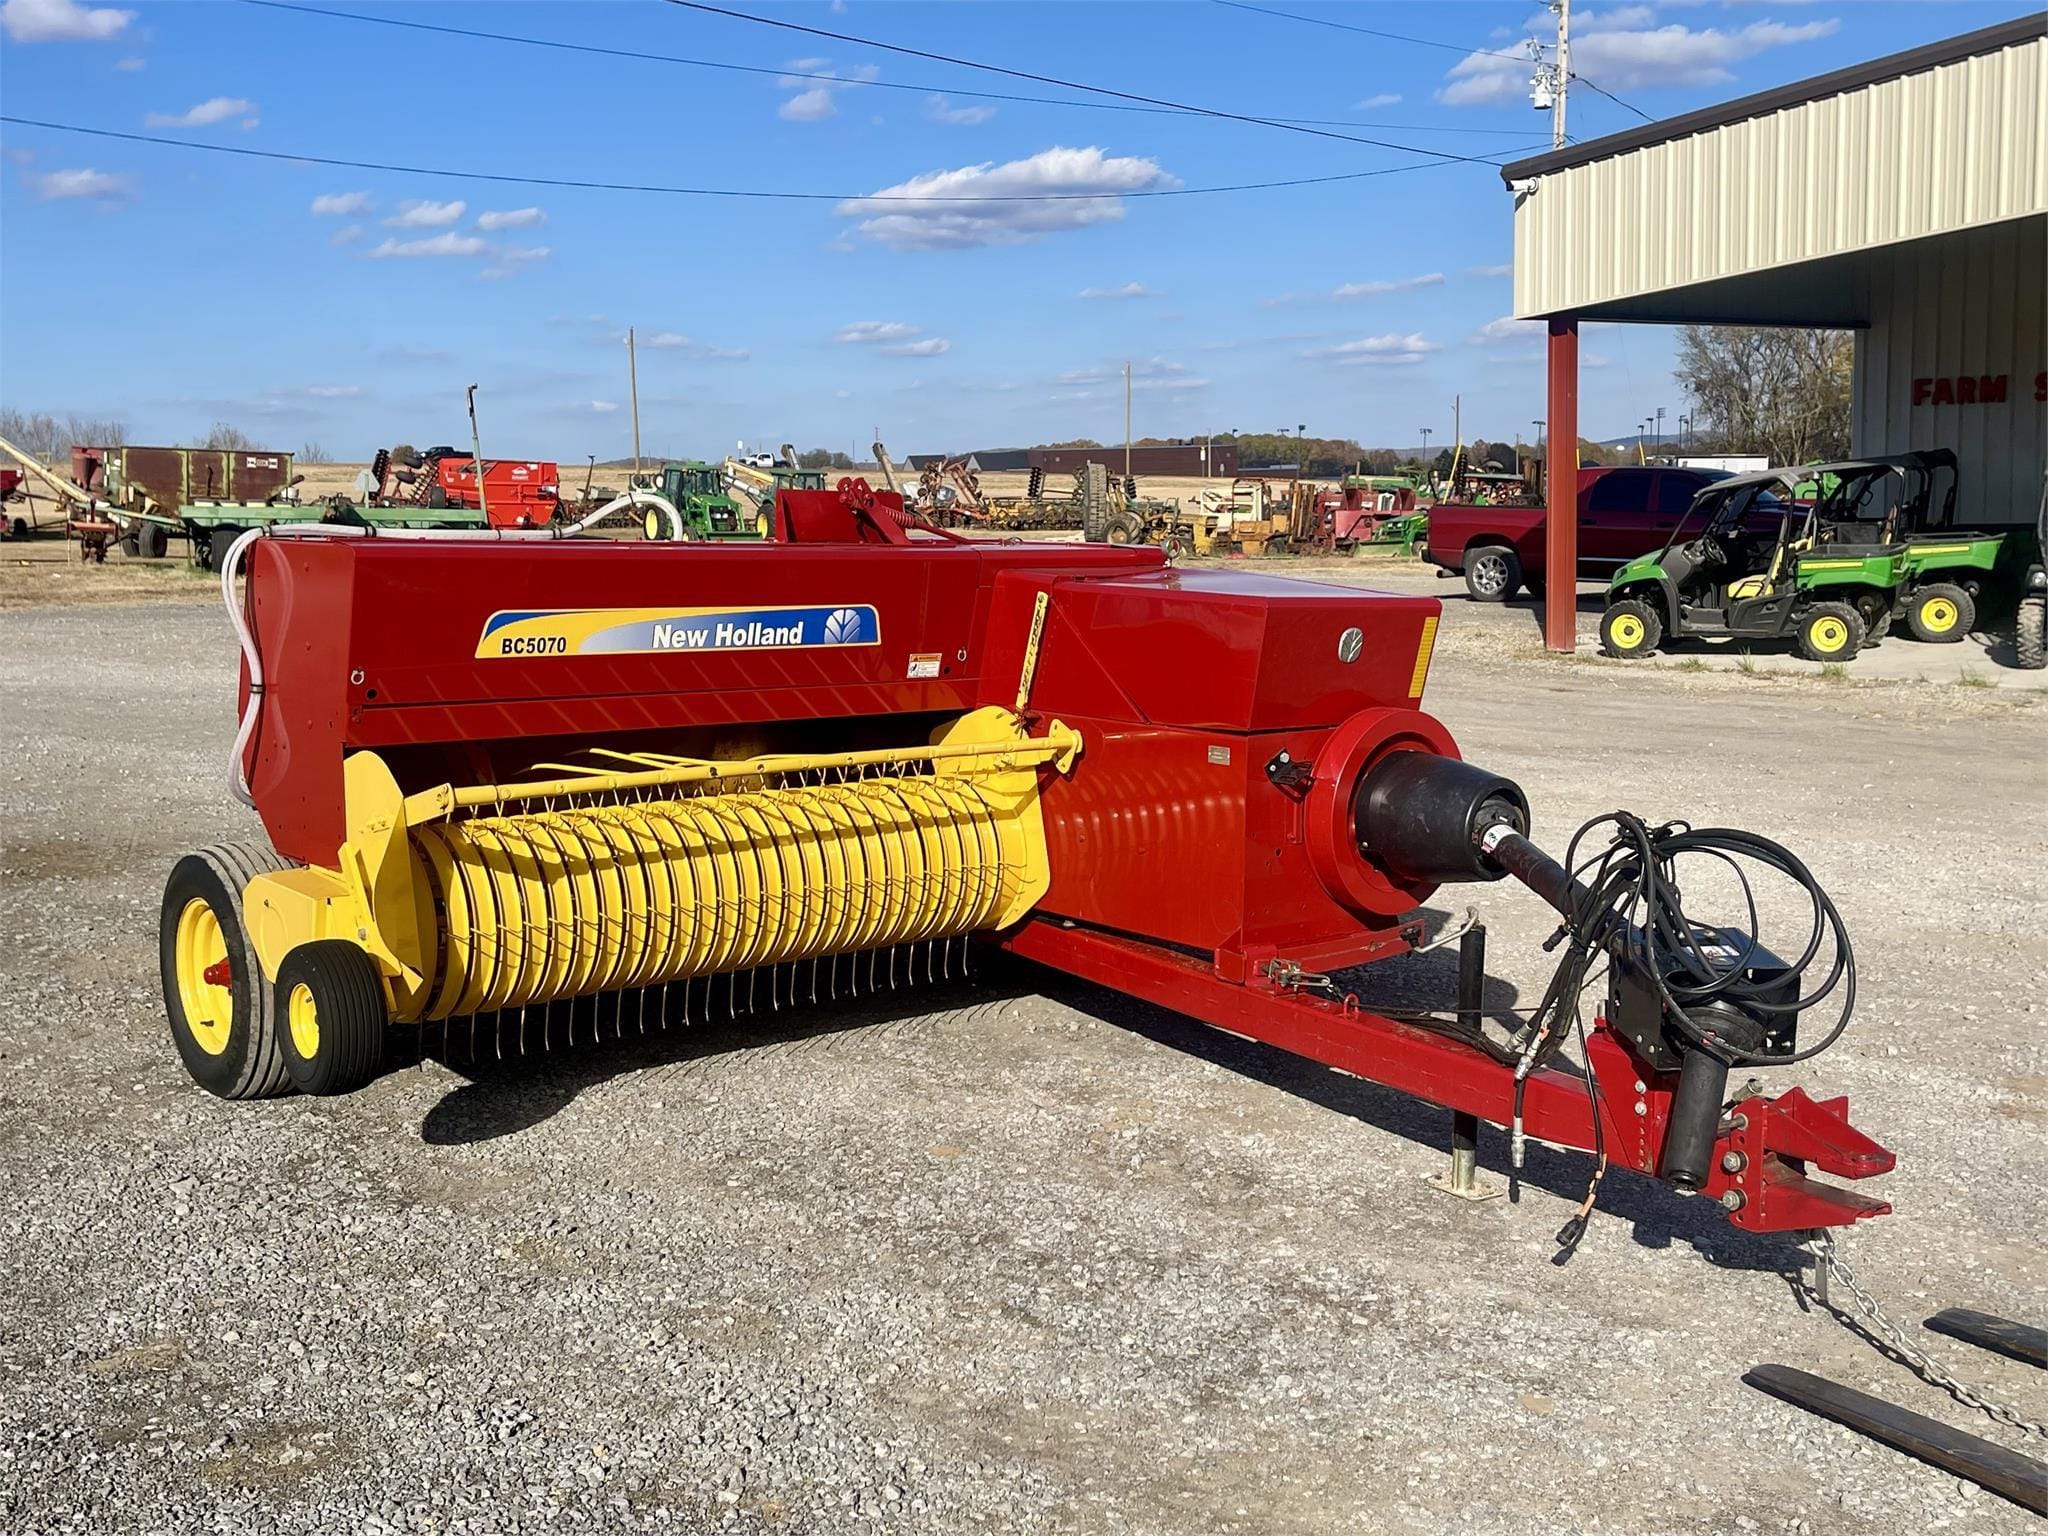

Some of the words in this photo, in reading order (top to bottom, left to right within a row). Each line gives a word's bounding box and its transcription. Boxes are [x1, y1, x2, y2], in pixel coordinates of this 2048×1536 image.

[1913, 375, 2008, 406] FARM
[501, 637, 567, 655] BC5070
[652, 624, 709, 649] New
[715, 621, 804, 647] Holland
